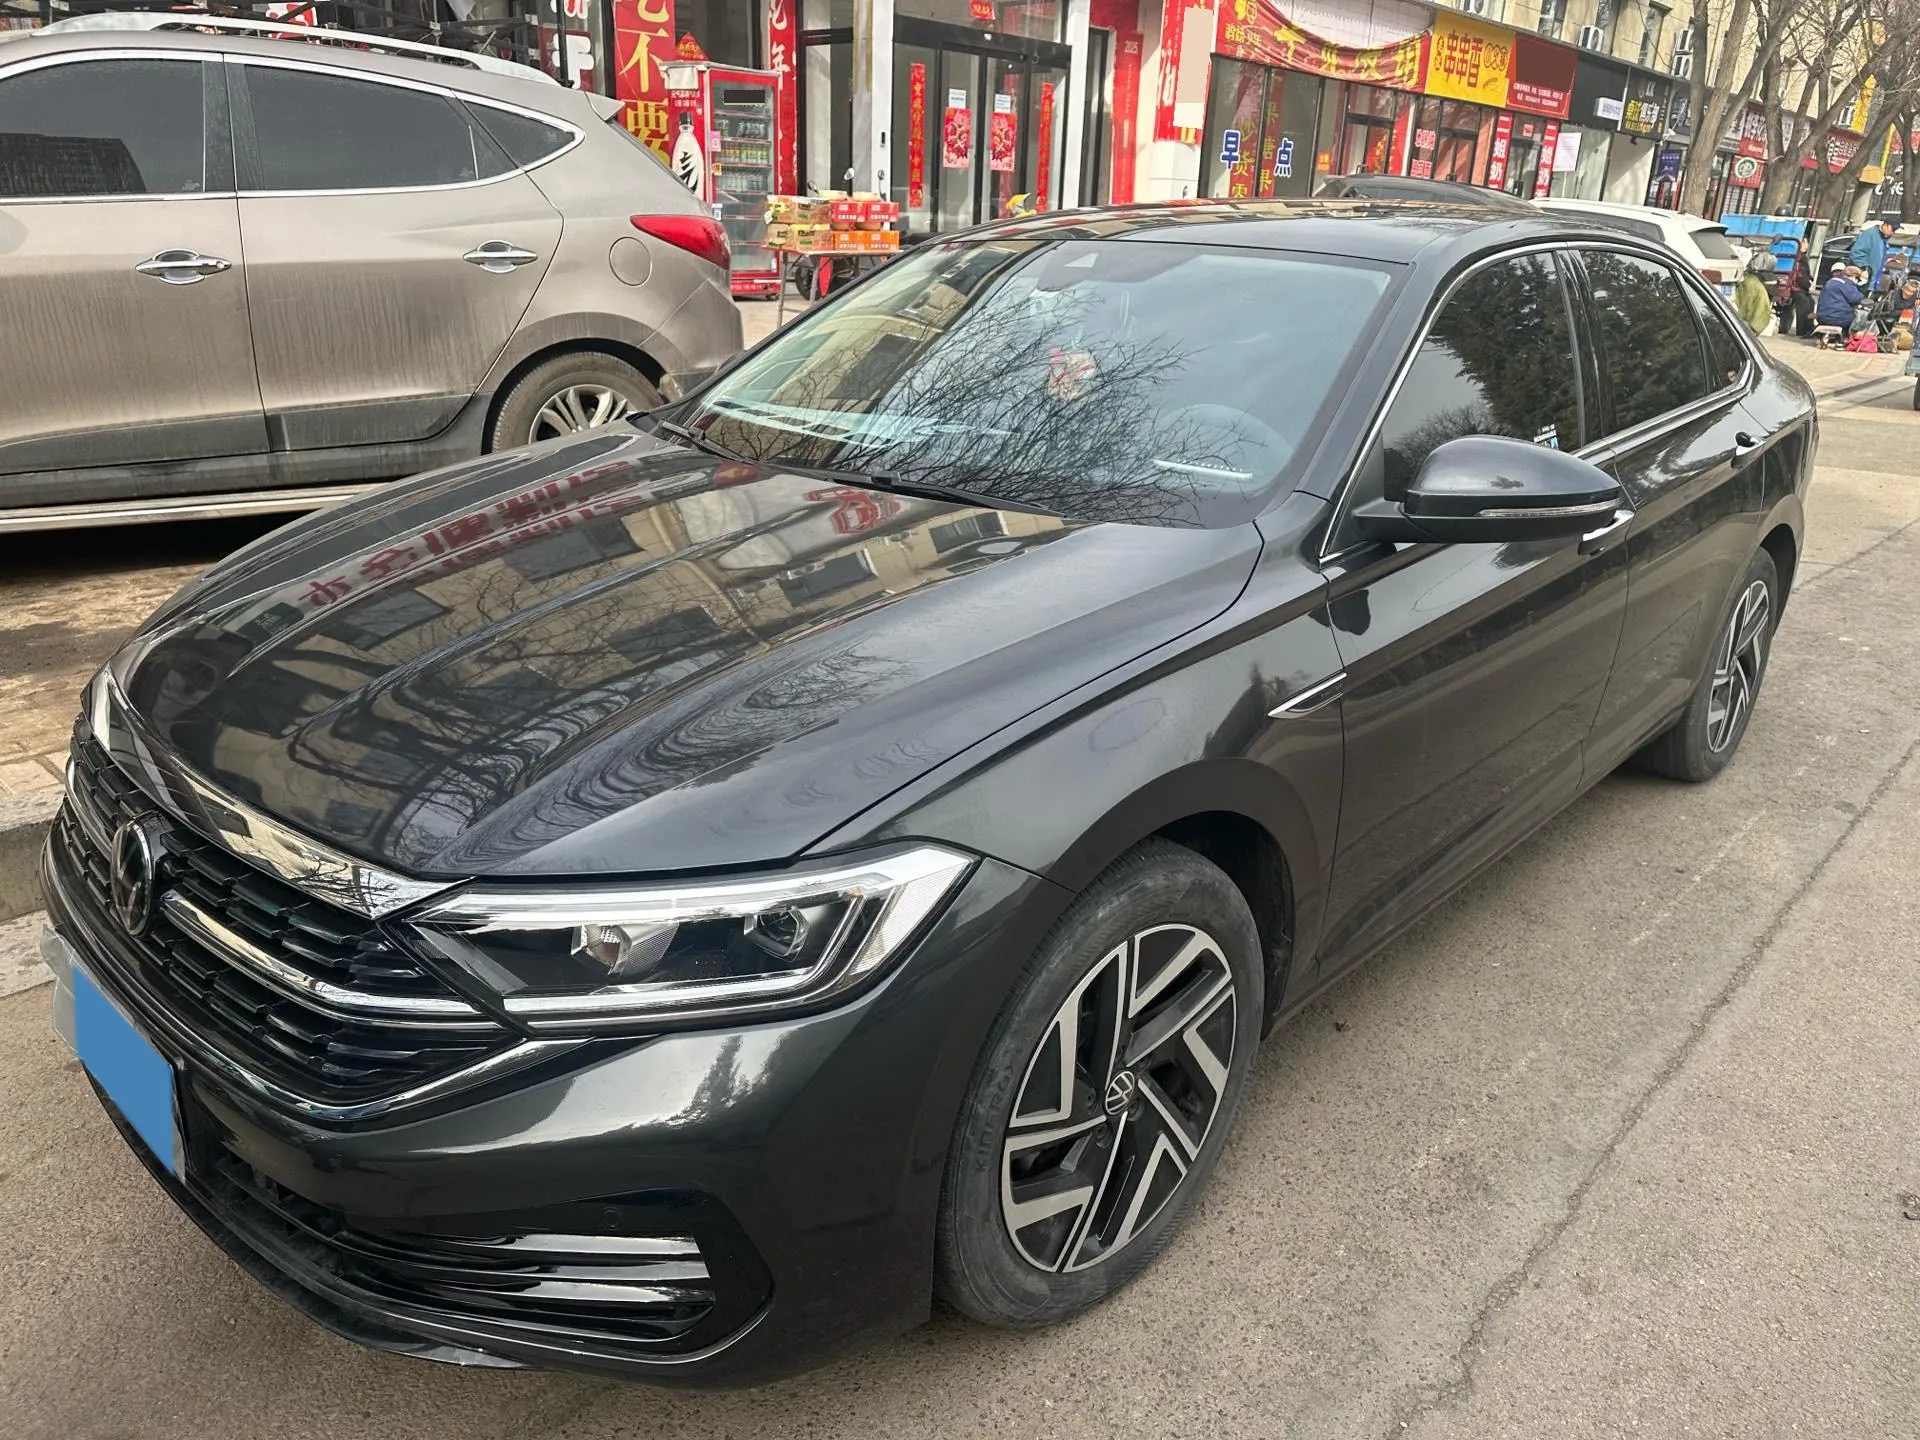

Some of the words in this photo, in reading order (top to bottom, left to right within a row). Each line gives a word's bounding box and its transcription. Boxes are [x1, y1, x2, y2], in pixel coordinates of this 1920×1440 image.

[1444, 29, 1483, 88] 串串香
[1488, 116, 1511, 188] 二姐奶
